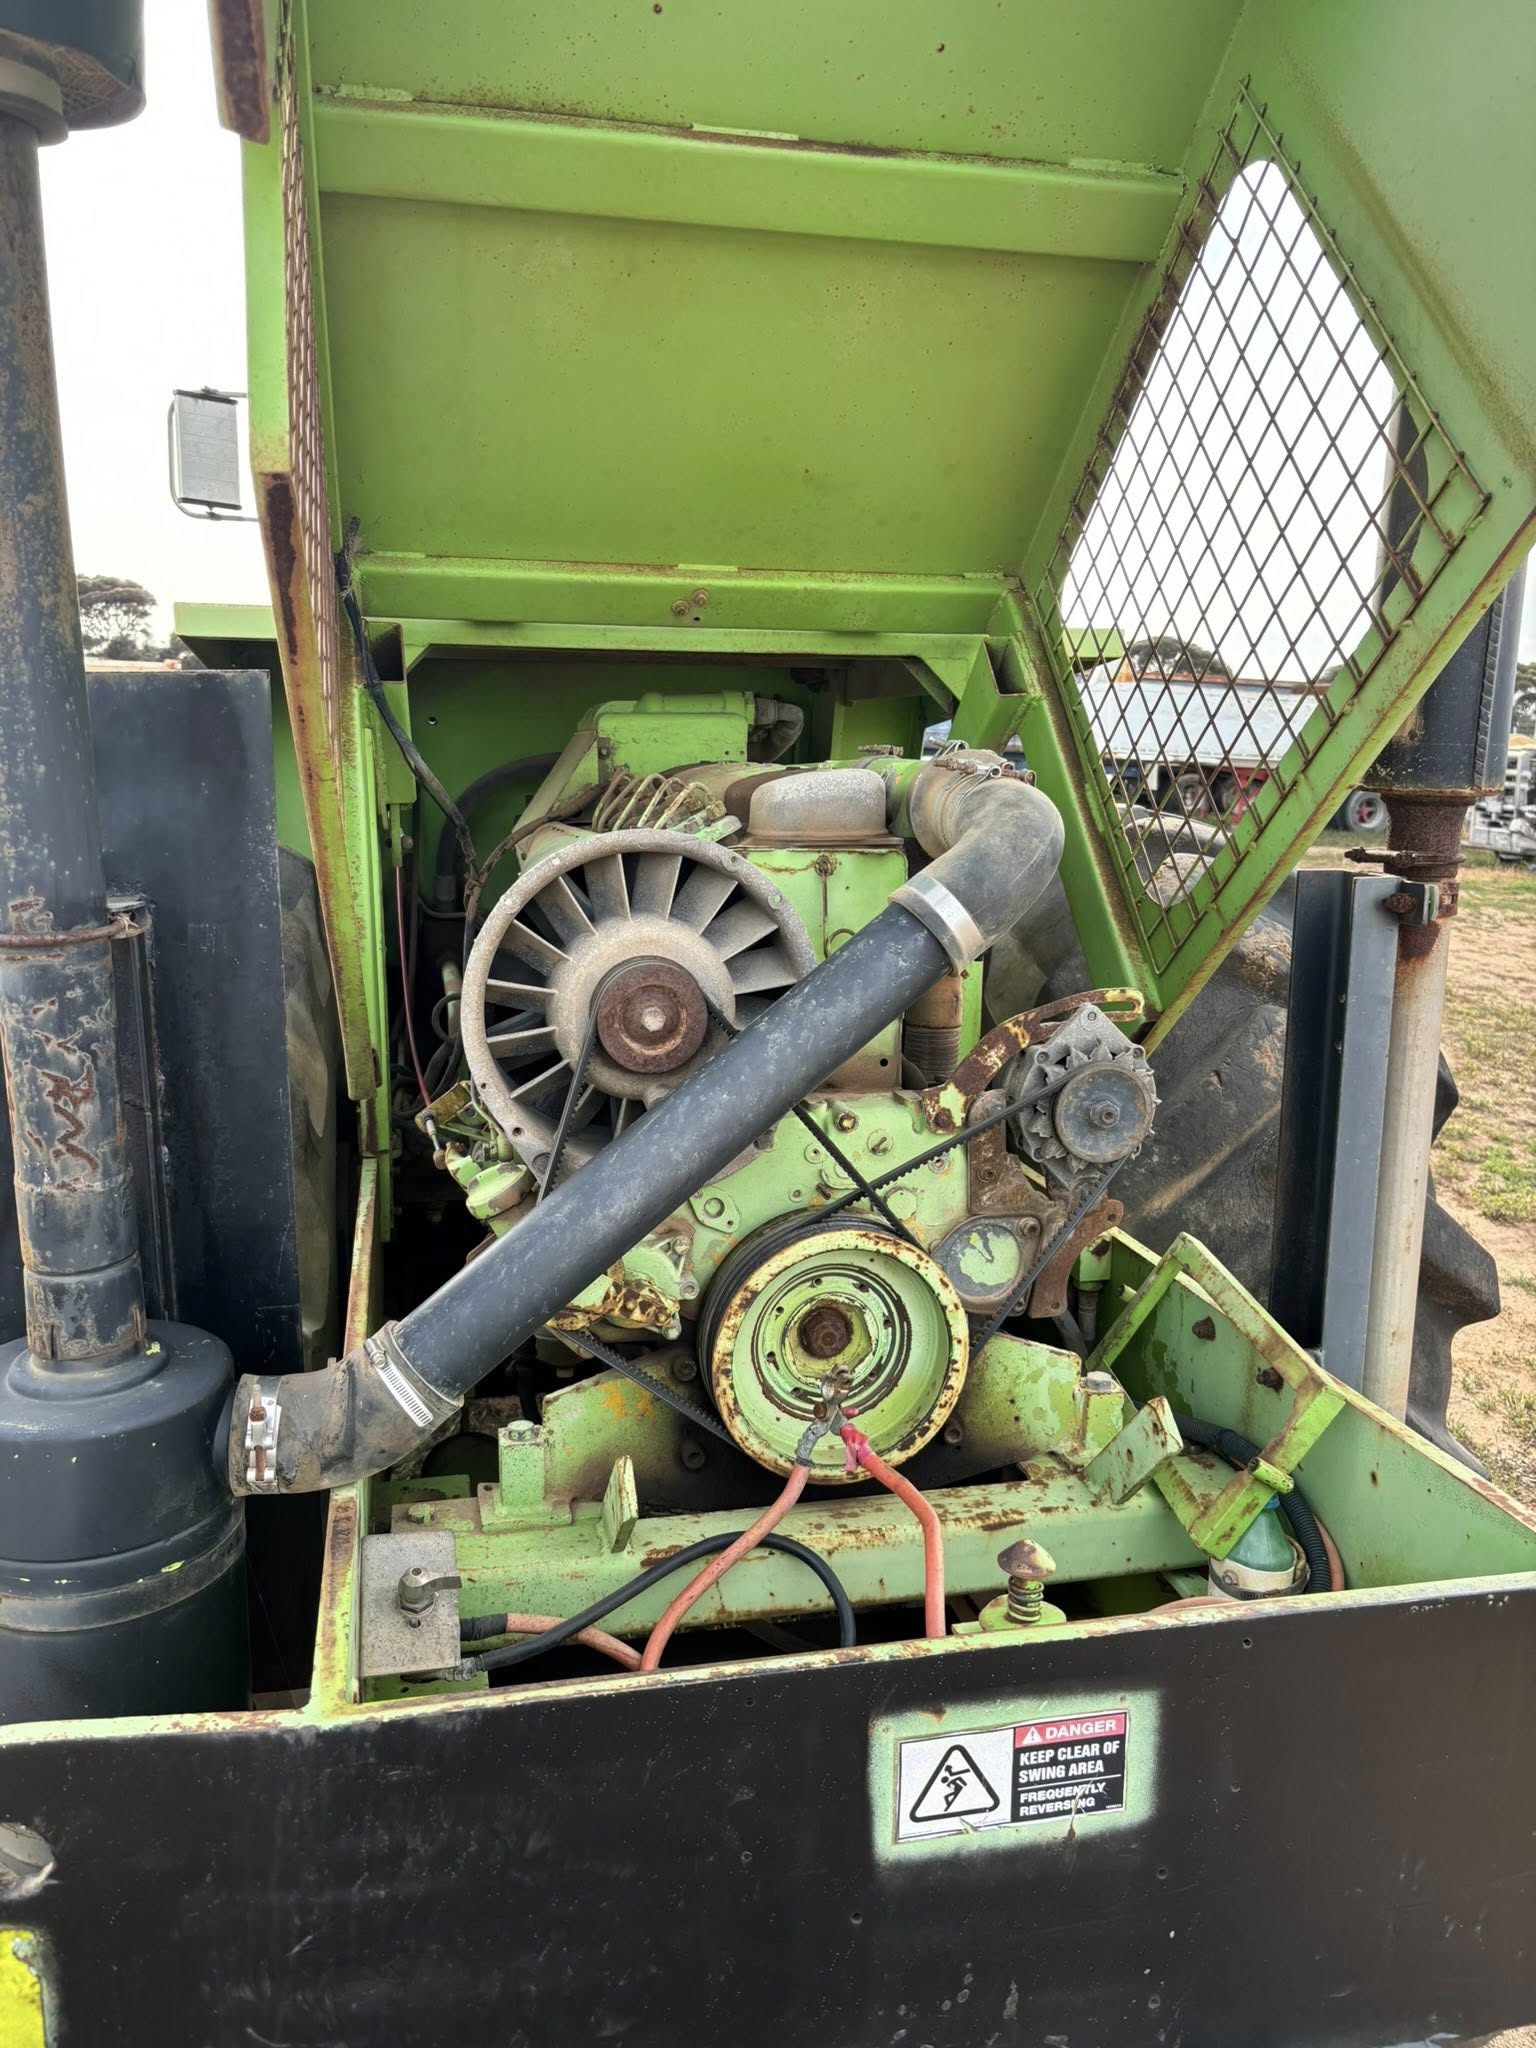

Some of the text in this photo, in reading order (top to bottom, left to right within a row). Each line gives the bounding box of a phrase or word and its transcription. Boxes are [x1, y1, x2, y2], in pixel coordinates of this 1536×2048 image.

[1045, 1719, 1117, 1740] DANGER
[1019, 1740, 1120, 1766] KEEP CLEAR OF
[1018, 1760, 1104, 1784] SWING AREA
[1020, 1782, 1106, 1804] FREQUENTLY
